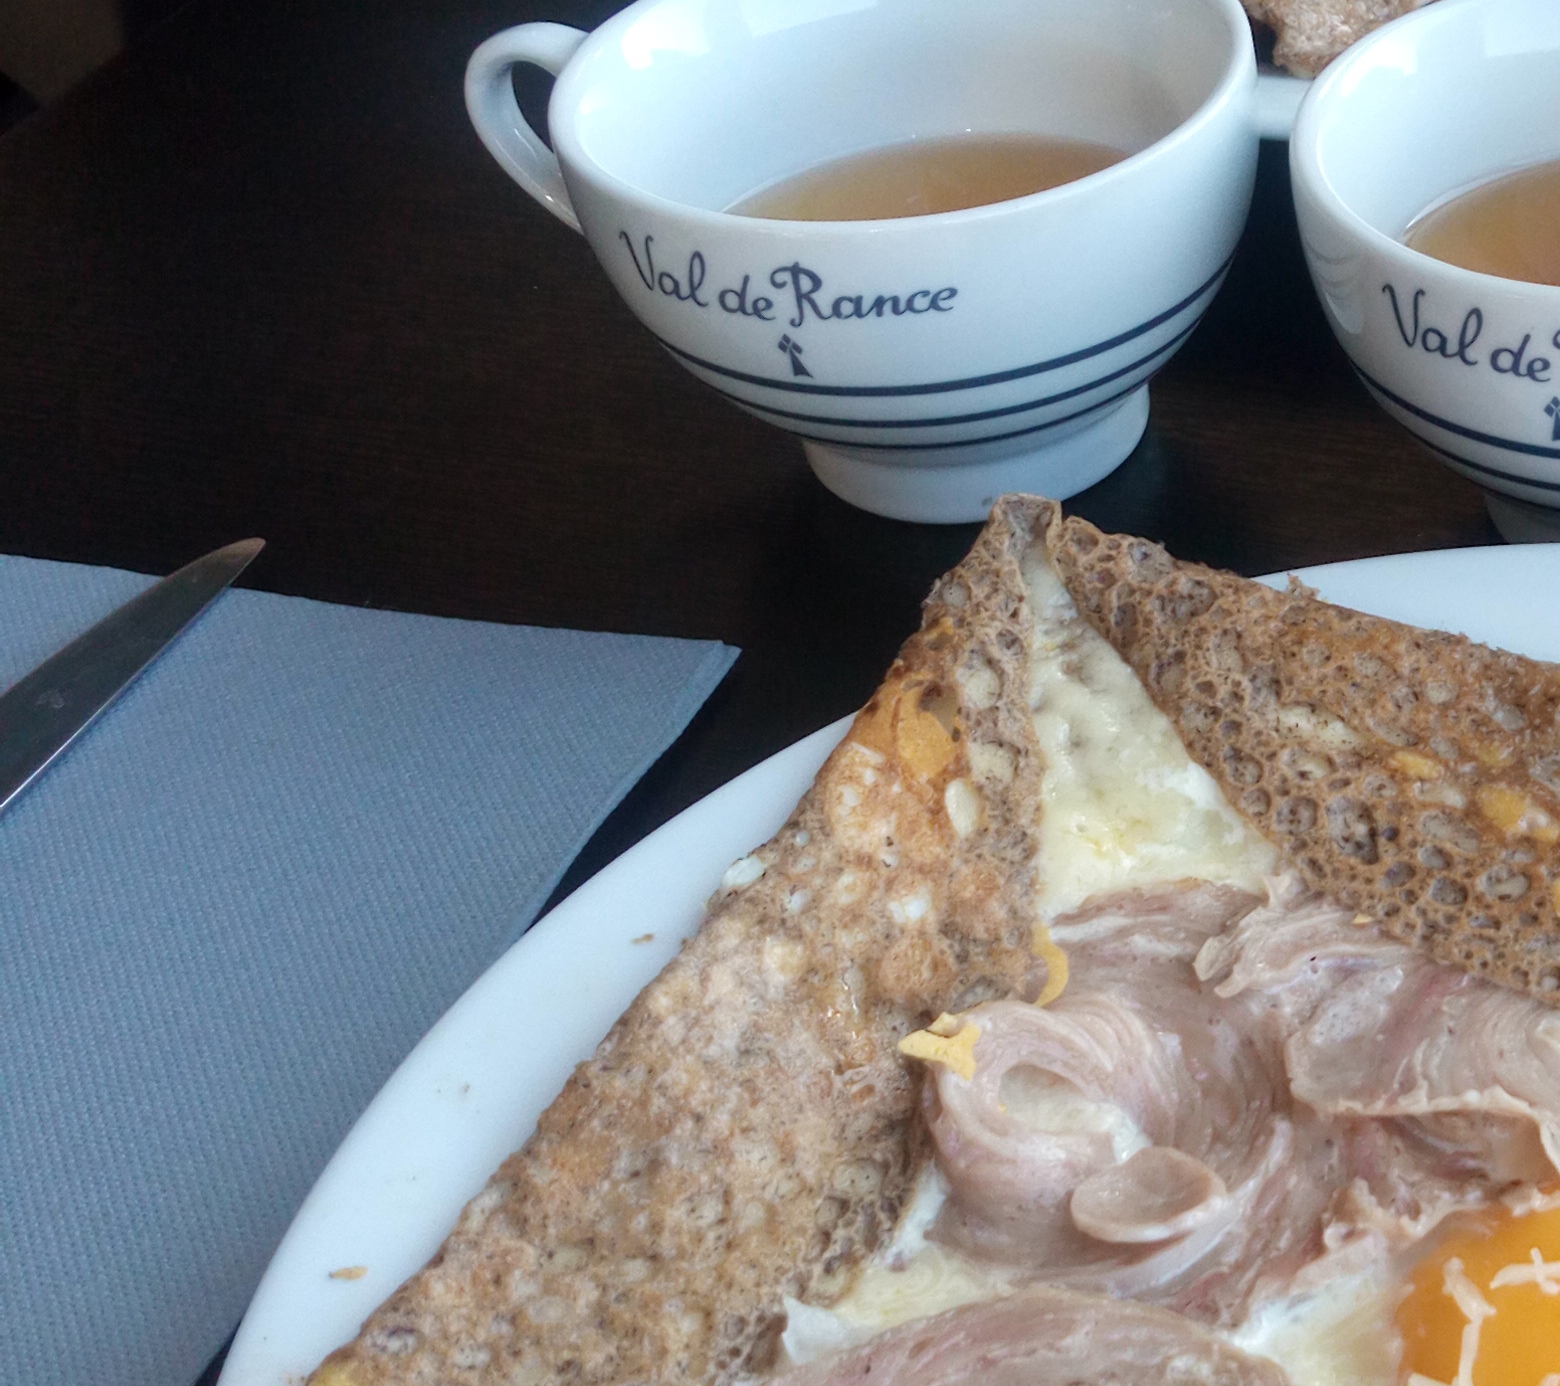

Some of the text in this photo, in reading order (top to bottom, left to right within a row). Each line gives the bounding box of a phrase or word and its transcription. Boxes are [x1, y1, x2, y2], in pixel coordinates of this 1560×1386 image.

[619, 230, 959, 328] Val de Rance
[1382, 283, 1484, 367] Val
[1489, 333, 1551, 384] de
